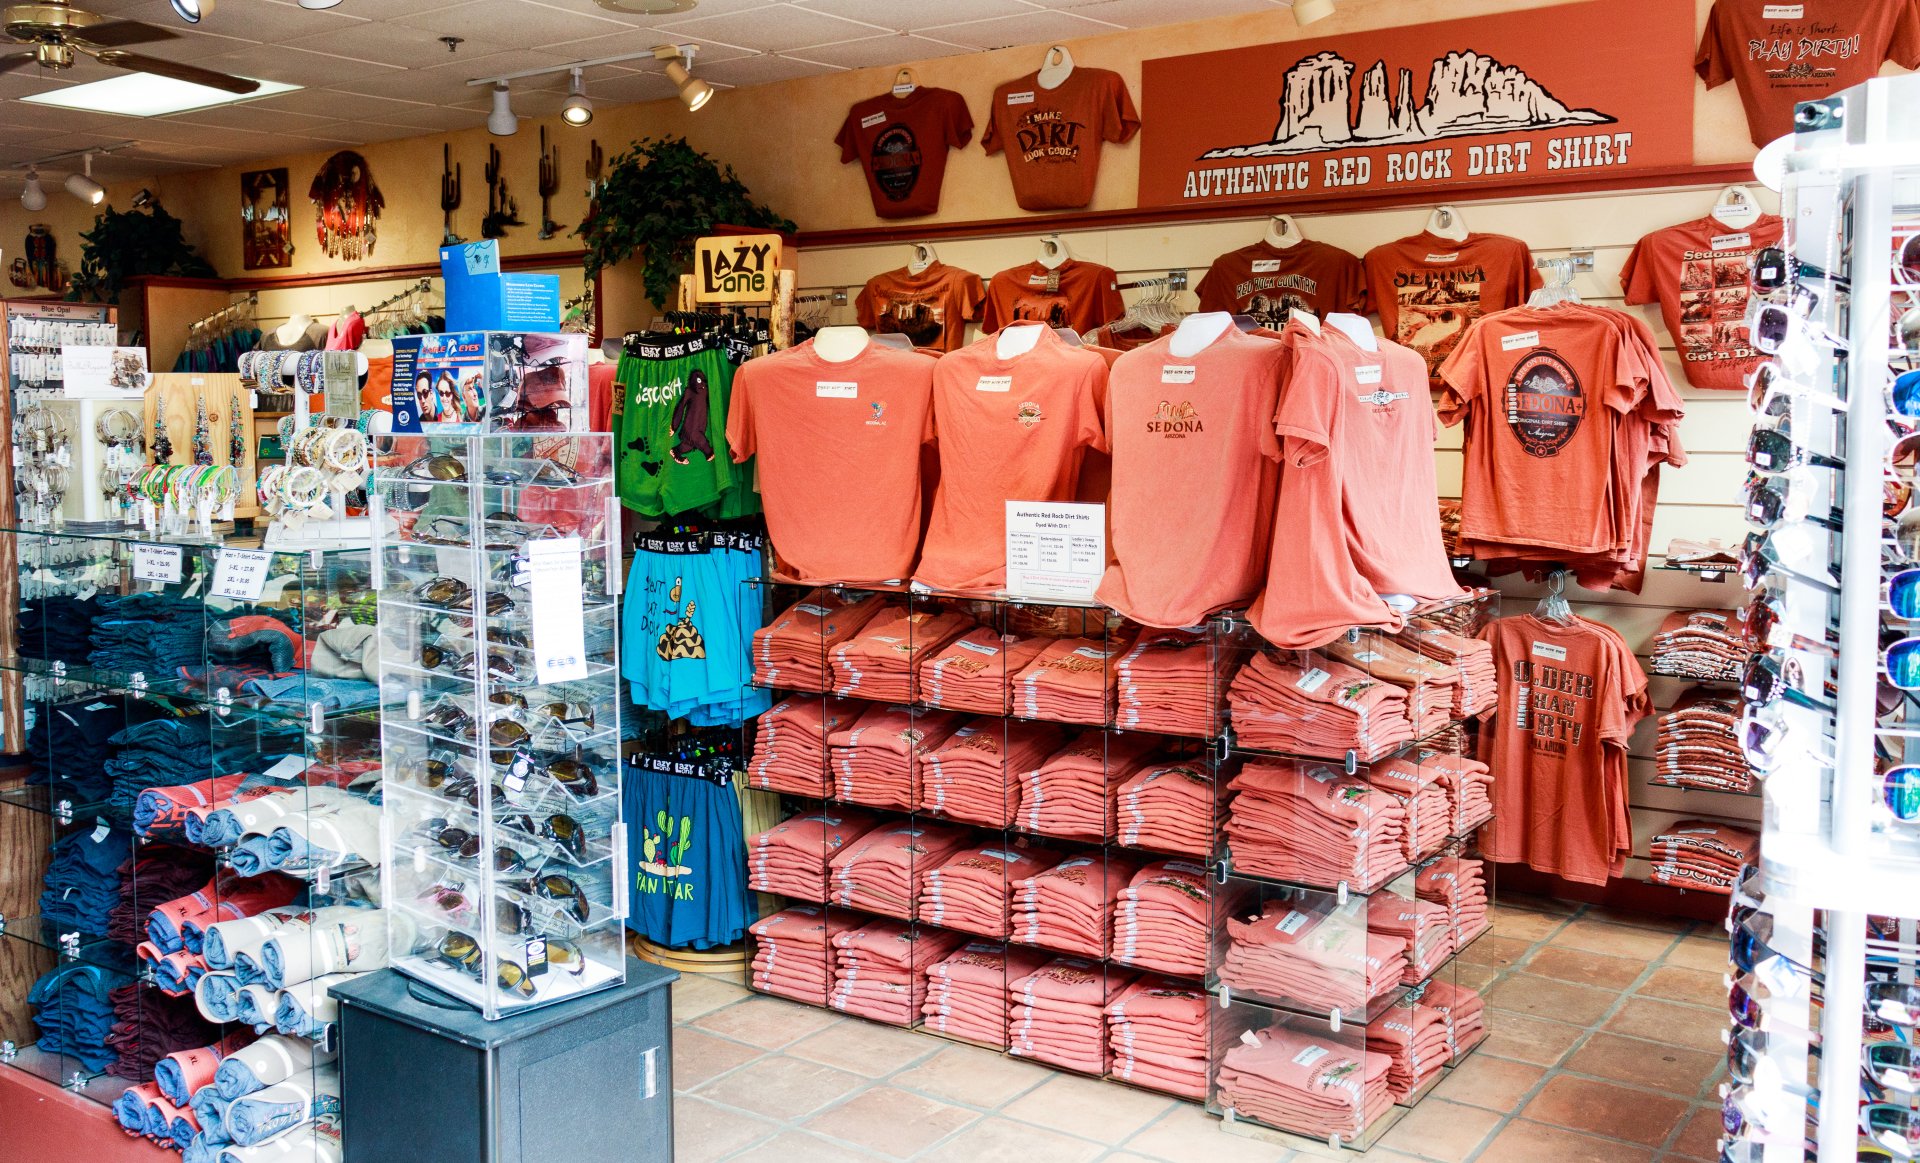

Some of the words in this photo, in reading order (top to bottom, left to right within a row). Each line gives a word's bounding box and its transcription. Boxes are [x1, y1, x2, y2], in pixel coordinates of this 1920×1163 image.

[1768, 23, 1792, 39] Life
[1796, 26, 1806, 36] is
[1748, 39, 1794, 61] PLAY
[1796, 34, 1860, 60] DIRTY!
[1034, 111, 1062, 122] MAKE
[1016, 121, 1087, 154] DIRT
[1023, 149, 1045, 163] LOOK
[1183, 161, 1309, 198] AUTHENTIC
[1323, 156, 1372, 188] RED
[1386, 149, 1452, 183] ROCK
[1468, 141, 1532, 176] DIRT
[1547, 132, 1633, 170] SHIRT
[1683, 250, 1747, 261] Sedona
[702, 243, 771, 293] LAZY
[1393, 264, 1487, 288] SEDONA
[1236, 281, 1253, 300] RED
[1255, 276, 1274, 292] ROCK
[1277, 274, 1317, 296] COUNTRY
[459, 343, 481, 352] EYES
[1685, 349, 1730, 362] Get'n
[1527, 358, 1538, 368] ON
[1552, 361, 1574, 384] ROCKS
[1146, 420, 1204, 433] SEDONA
[1532, 690, 1578, 718] HAN
